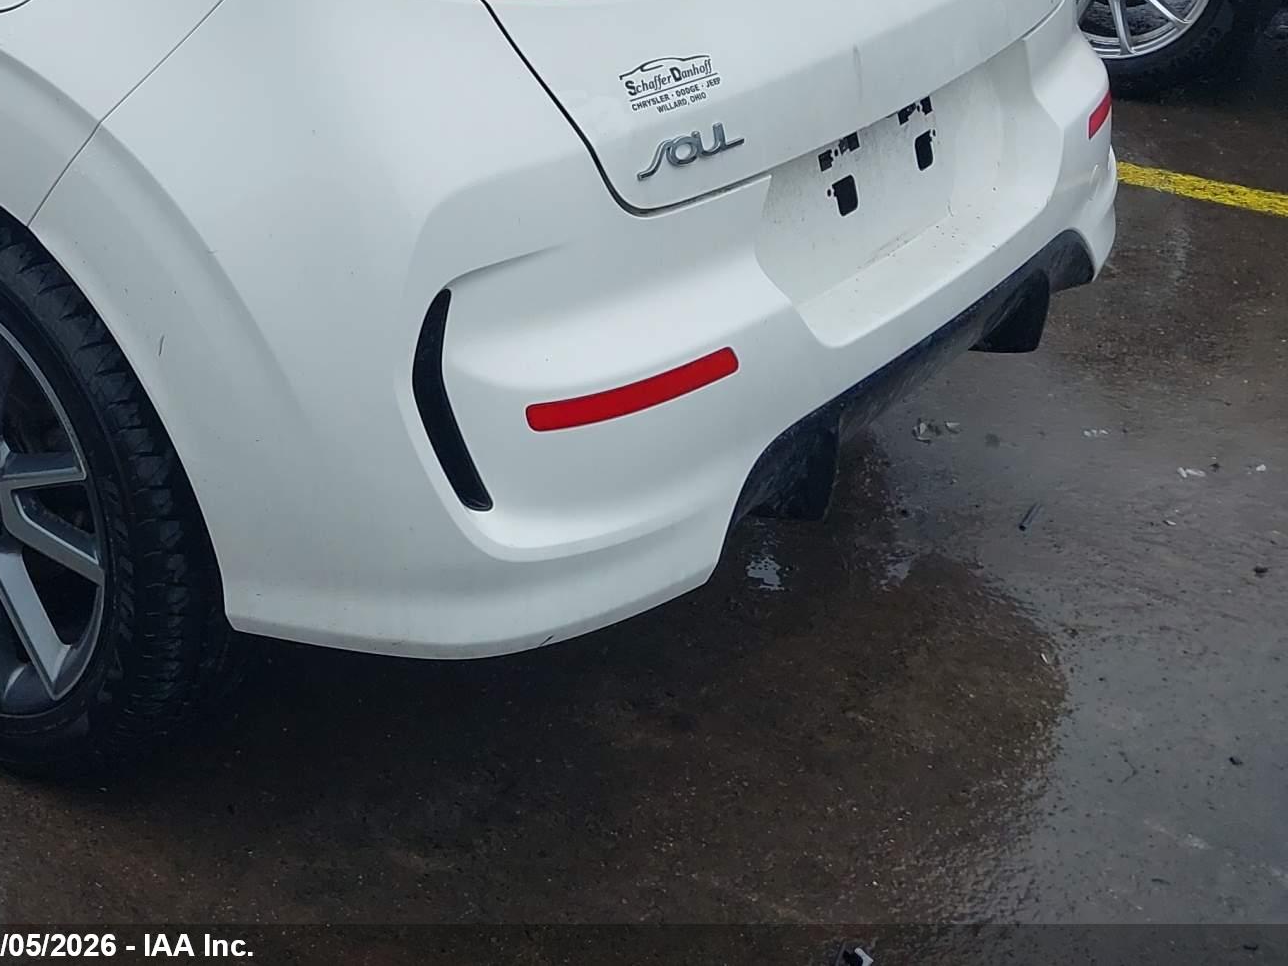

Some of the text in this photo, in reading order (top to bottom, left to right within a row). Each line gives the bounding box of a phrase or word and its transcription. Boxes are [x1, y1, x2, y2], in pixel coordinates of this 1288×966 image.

[631, 77, 721, 112] CHRYSLER DODGE JEEP
[690, 91, 707, 104] OHIO
